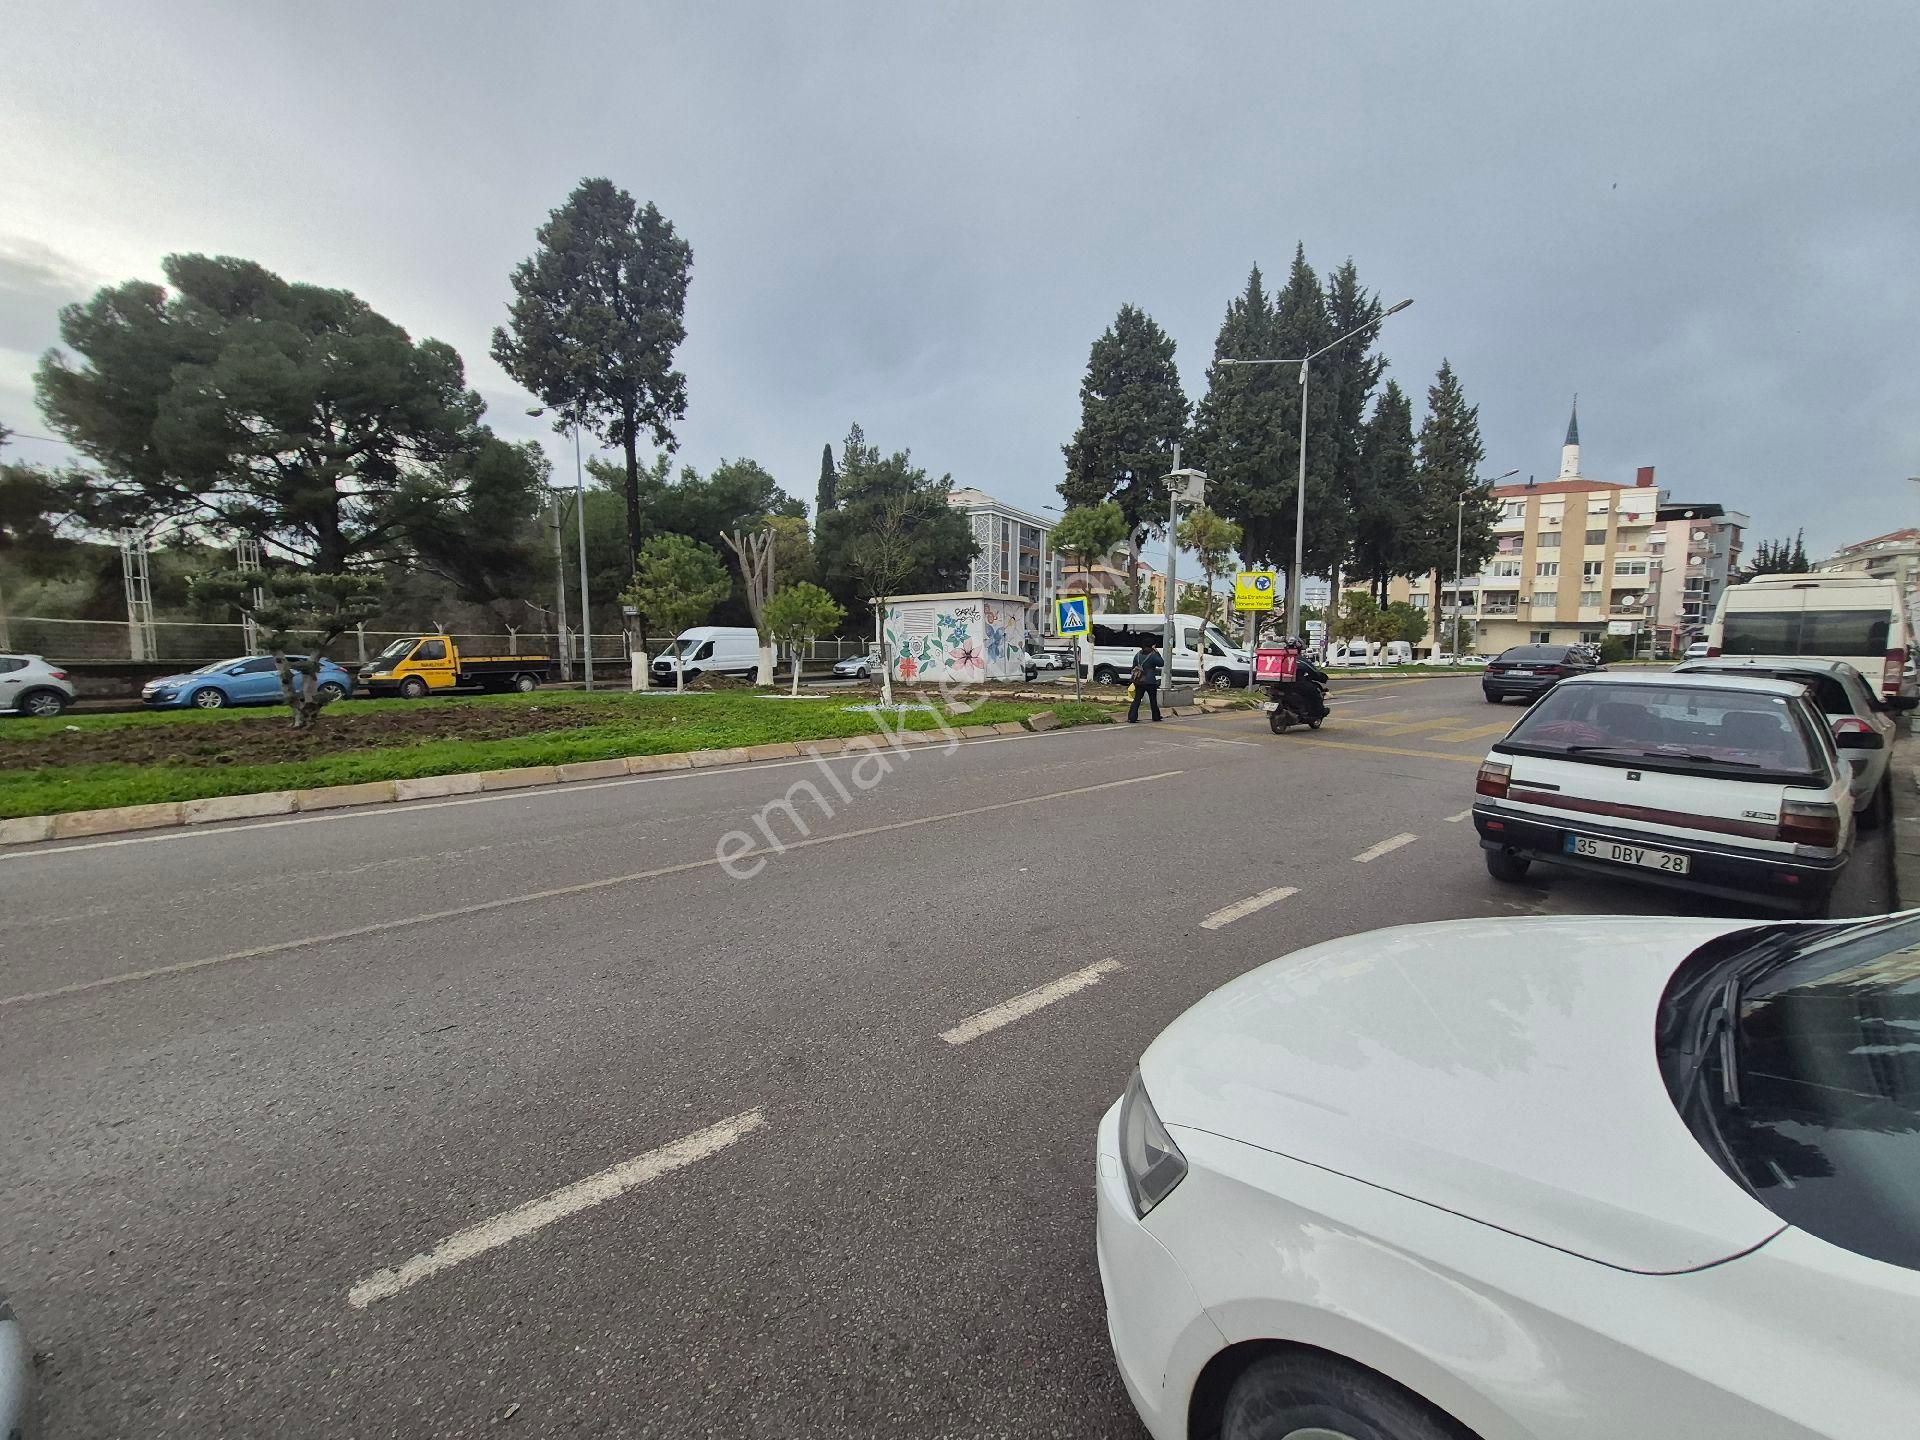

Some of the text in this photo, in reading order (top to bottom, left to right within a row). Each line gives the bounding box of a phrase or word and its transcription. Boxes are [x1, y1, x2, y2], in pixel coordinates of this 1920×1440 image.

[1577, 839, 1684, 872] 35 DBV 28
